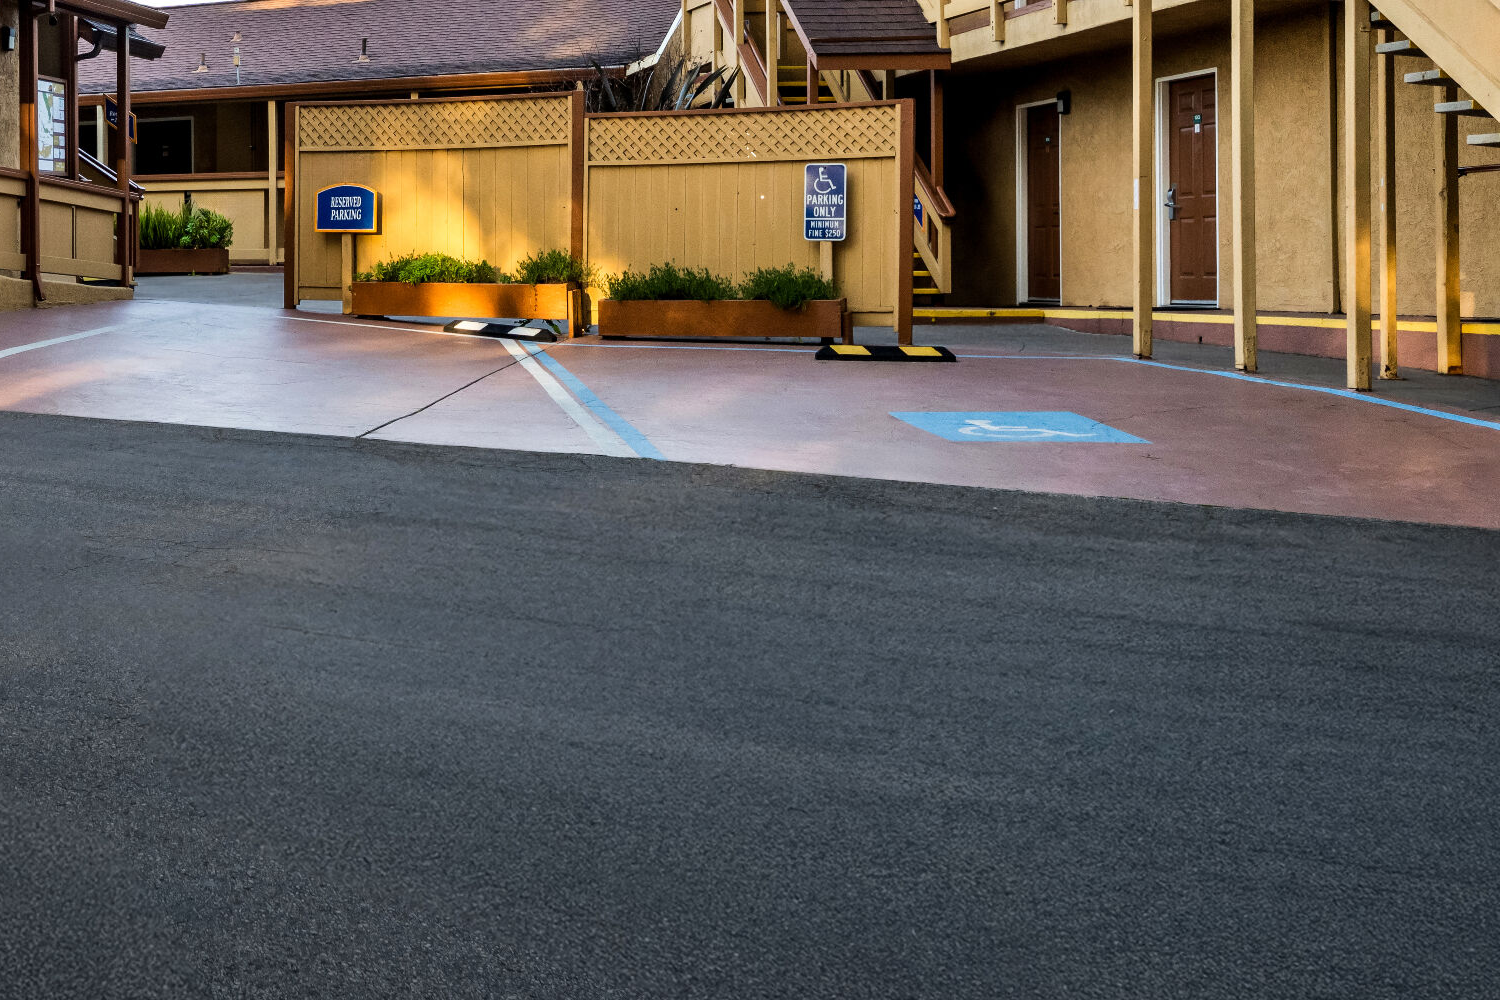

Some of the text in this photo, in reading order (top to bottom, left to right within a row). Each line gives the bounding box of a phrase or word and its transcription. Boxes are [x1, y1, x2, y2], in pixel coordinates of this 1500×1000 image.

[330, 196, 362, 208] RESERVED
[806, 194, 844, 205] PARKING
[330, 209, 362, 221] PARKING
[813, 206, 836, 217] ONLY
[810, 220, 839, 229] MINIMUM
[808, 229, 841, 238] FINE $250
